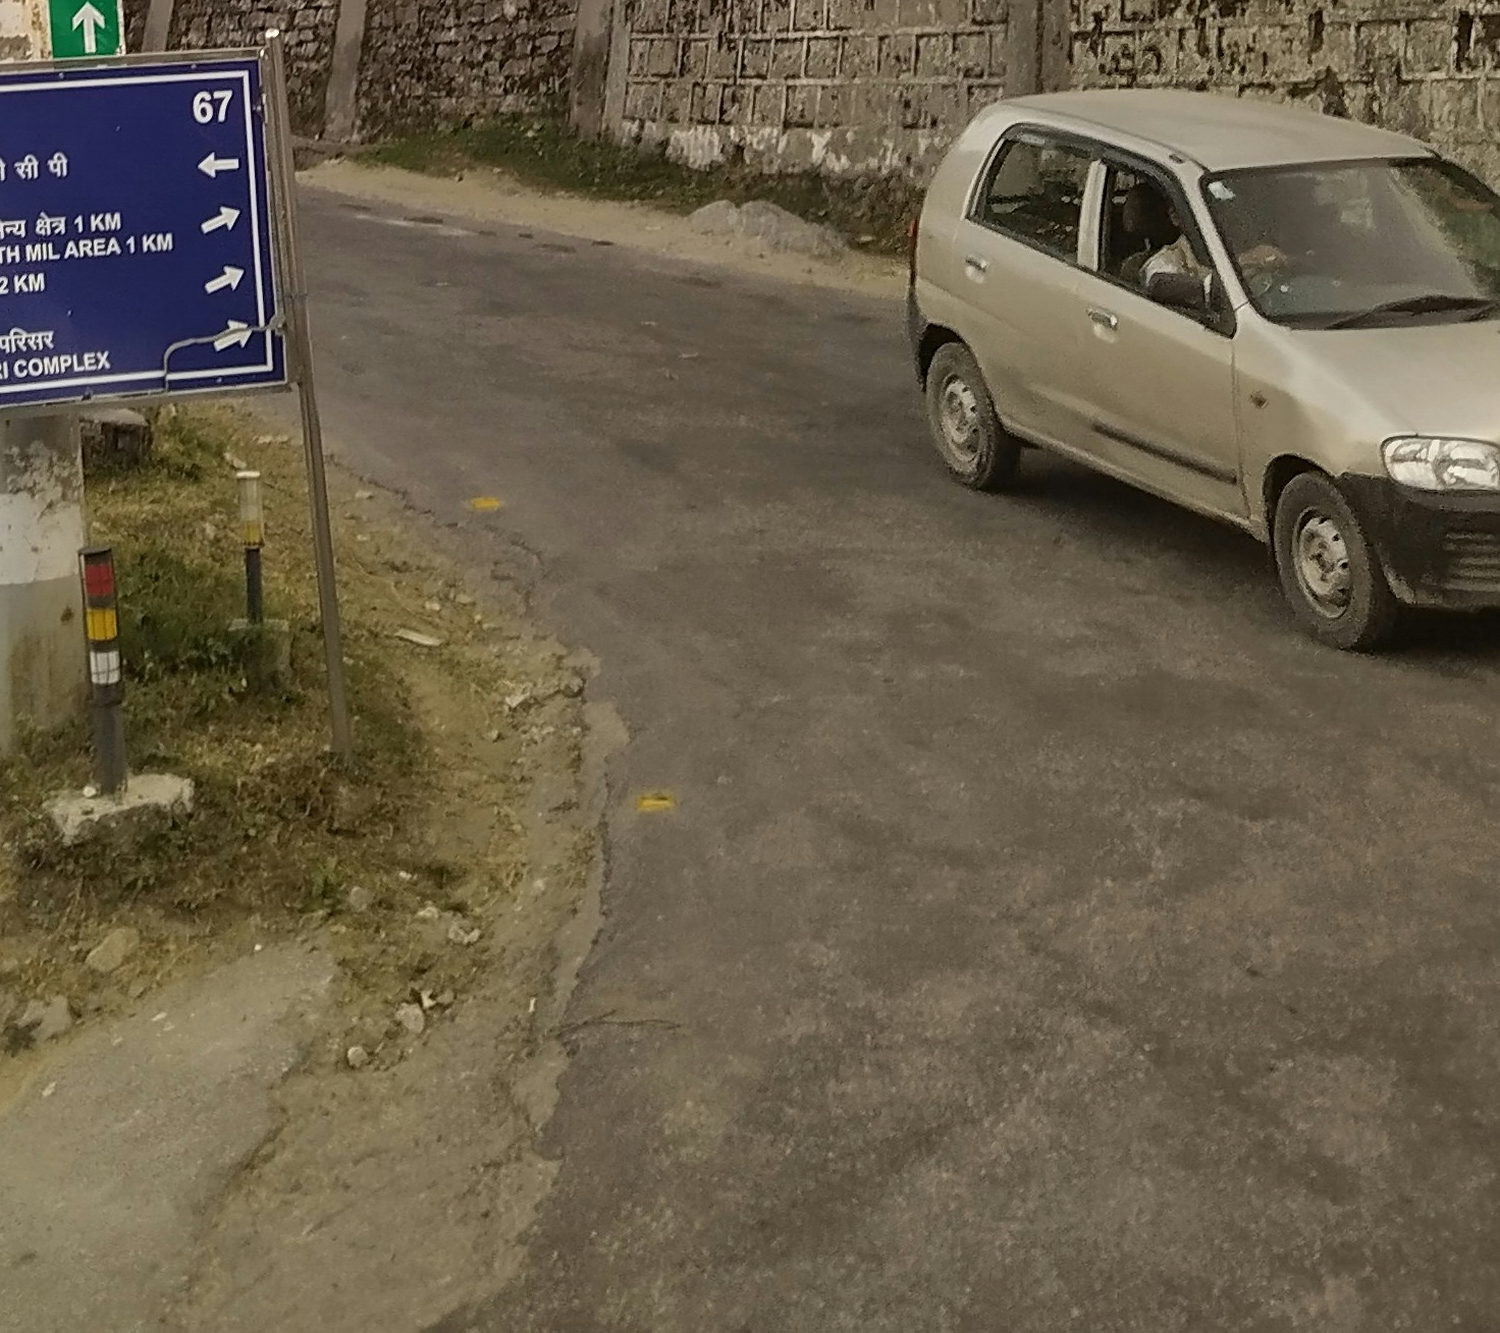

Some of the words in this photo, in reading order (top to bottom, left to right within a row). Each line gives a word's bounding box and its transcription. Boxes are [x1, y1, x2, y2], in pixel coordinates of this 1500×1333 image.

[192, 89, 233, 123] 67
[14, 154, 39, 179] सी
[47, 151, 68, 177] पी
[35, 212, 66, 236] क्षेत्र
[74, 215, 83, 233] 1
[90, 213, 121, 231] KM
[26, 242, 60, 263] MIL
[64, 239, 121, 259] AREA
[126, 237, 135, 254] 1
[142, 234, 173, 252] KM
[14, 273, 45, 293] KM
[13, 351, 110, 378] COMPLEX
